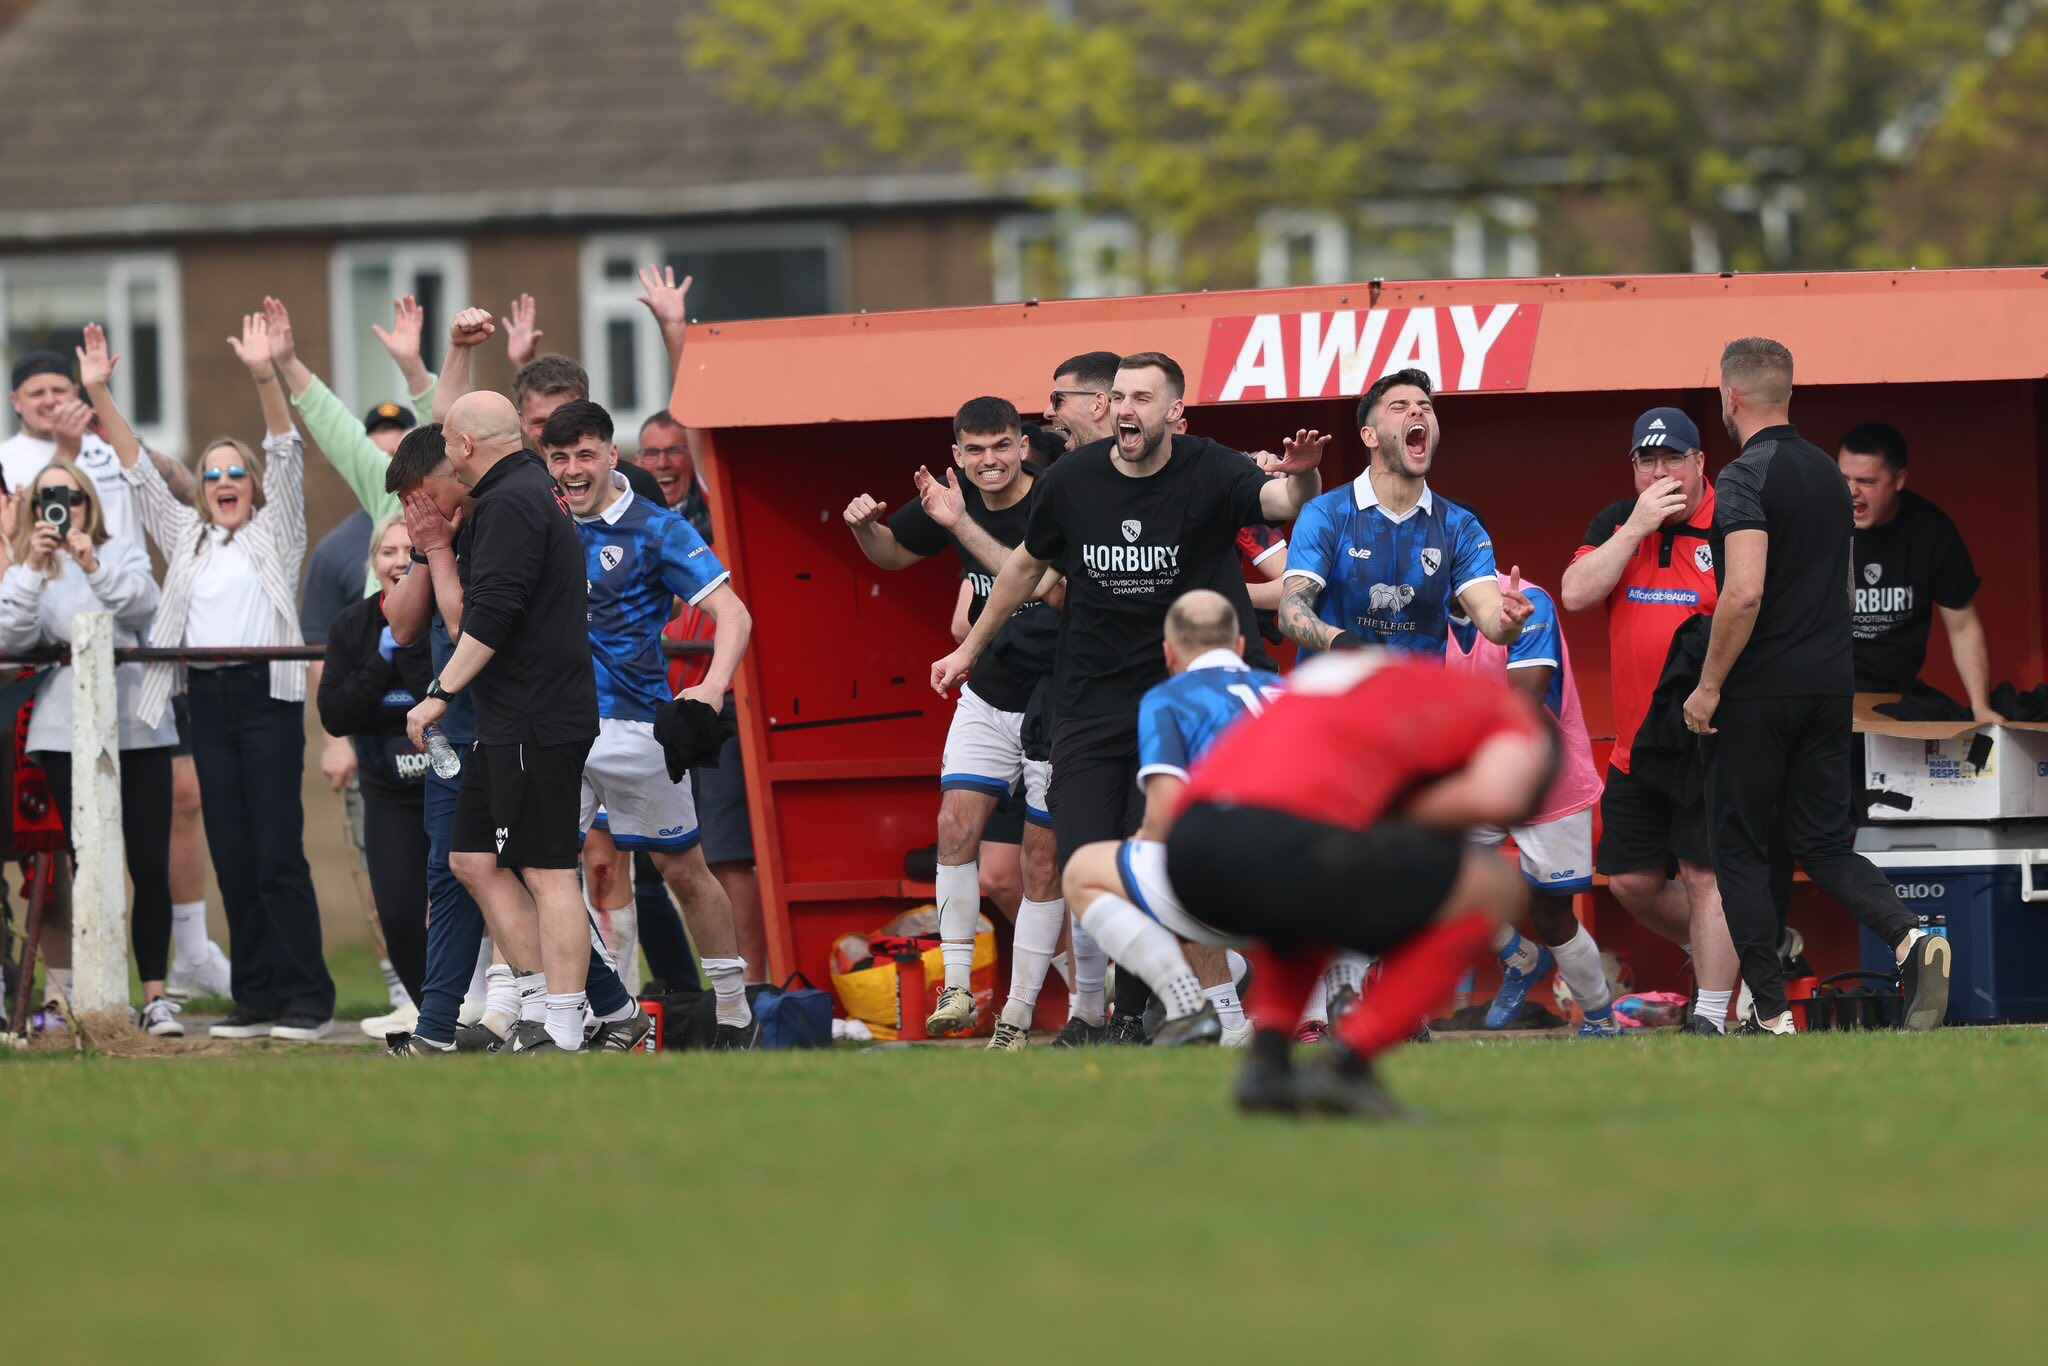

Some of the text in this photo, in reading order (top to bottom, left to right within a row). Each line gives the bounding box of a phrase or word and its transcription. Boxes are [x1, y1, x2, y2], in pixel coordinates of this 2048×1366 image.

[1219, 304, 1519, 401] AWAY
[1083, 544, 1180, 572] HORBURY
[1109, 579, 1139, 587] DIVISION
[1139, 578, 1155, 586] ONE
[1112, 585, 1155, 595] CHAMPIONS
[1855, 585, 1914, 613] RBURY
[1357, 616, 1378, 628] THE
[1929, 768, 1965, 779] RESPE
[1894, 883, 1945, 898] GLOO
